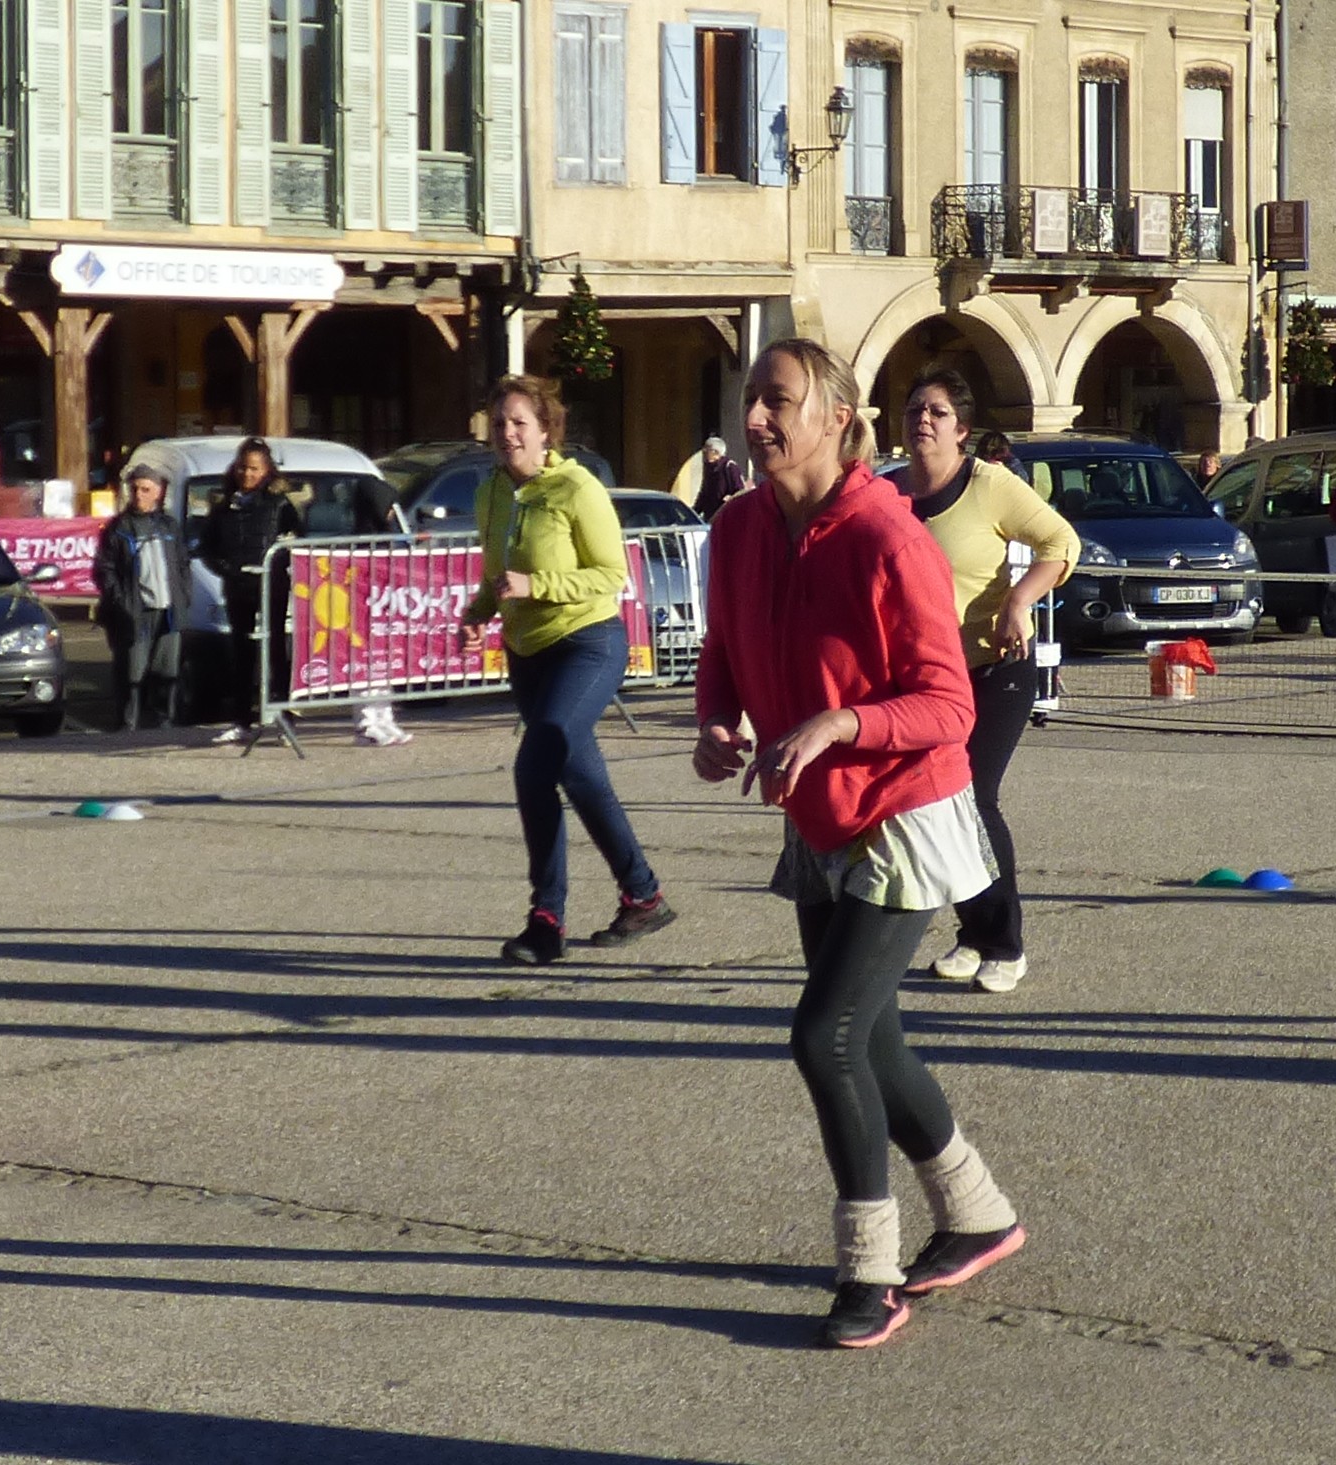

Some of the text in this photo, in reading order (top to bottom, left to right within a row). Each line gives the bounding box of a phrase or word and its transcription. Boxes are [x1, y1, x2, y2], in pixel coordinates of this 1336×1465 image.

[117, 261, 325, 287] OFFICE DE TOURISME
